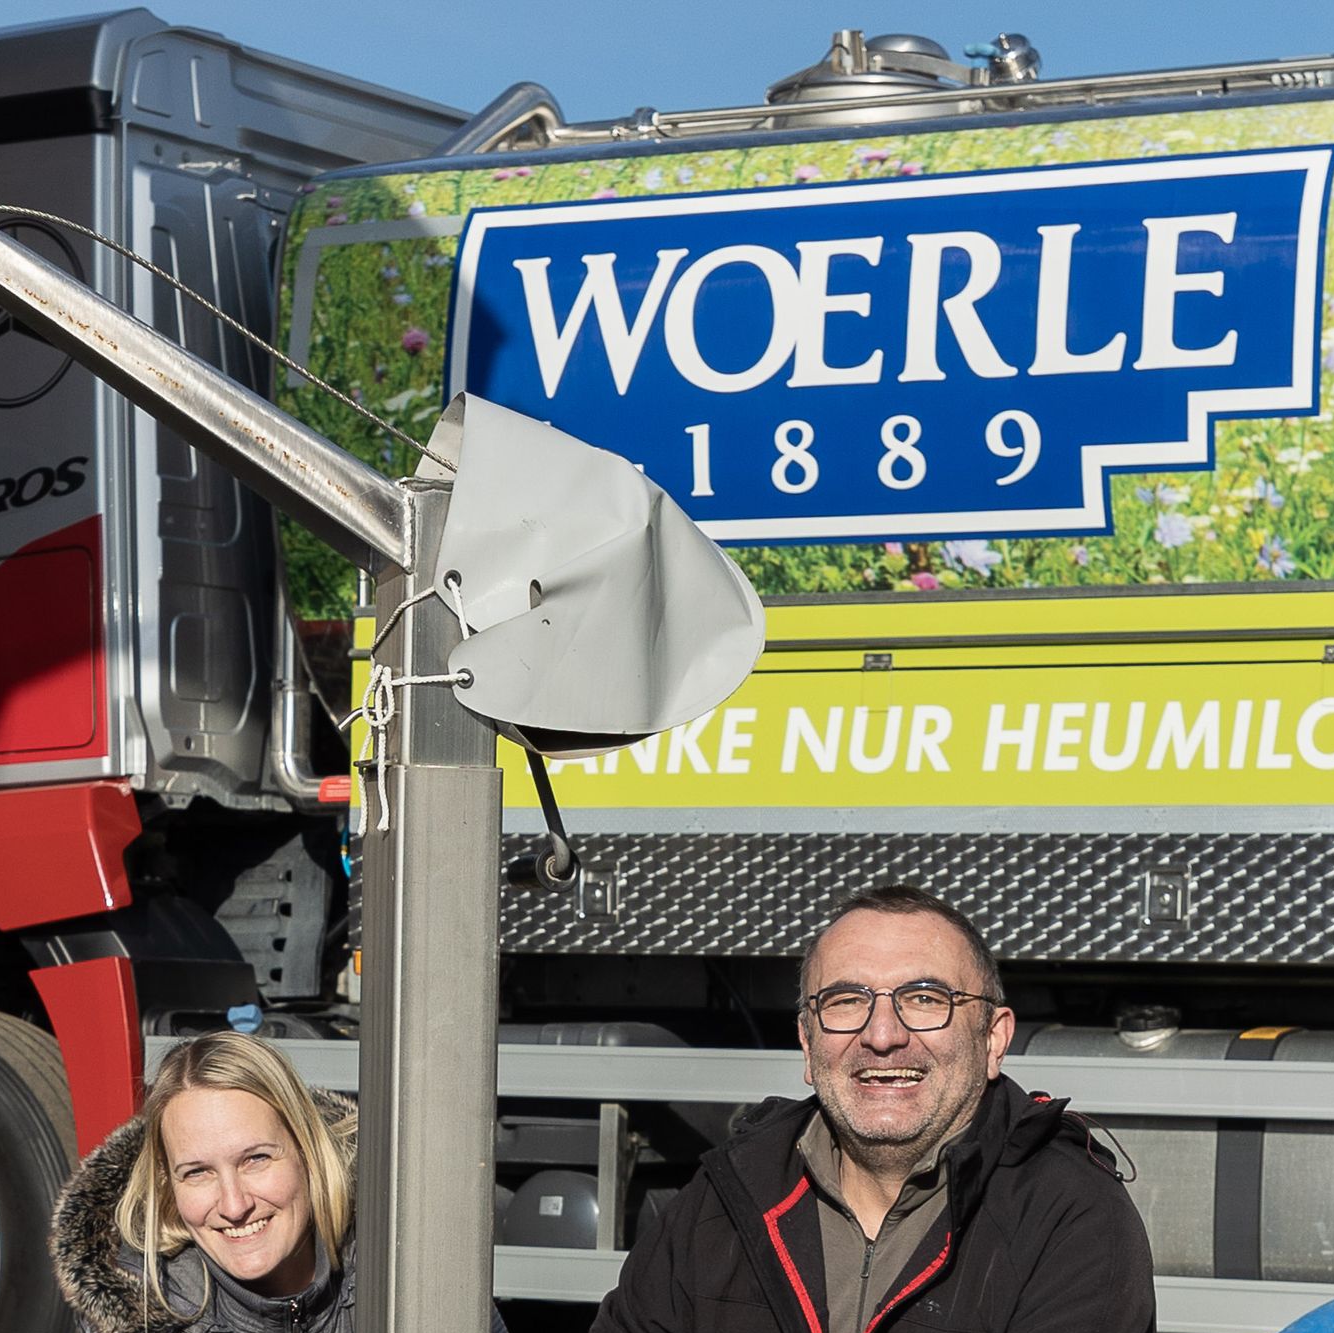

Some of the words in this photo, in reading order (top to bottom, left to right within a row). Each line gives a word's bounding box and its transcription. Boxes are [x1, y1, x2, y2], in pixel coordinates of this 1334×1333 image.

[513, 212, 1237, 399] WOERLE
[685, 409, 1042, 496] 1889
[780, 704, 950, 775] NUR
